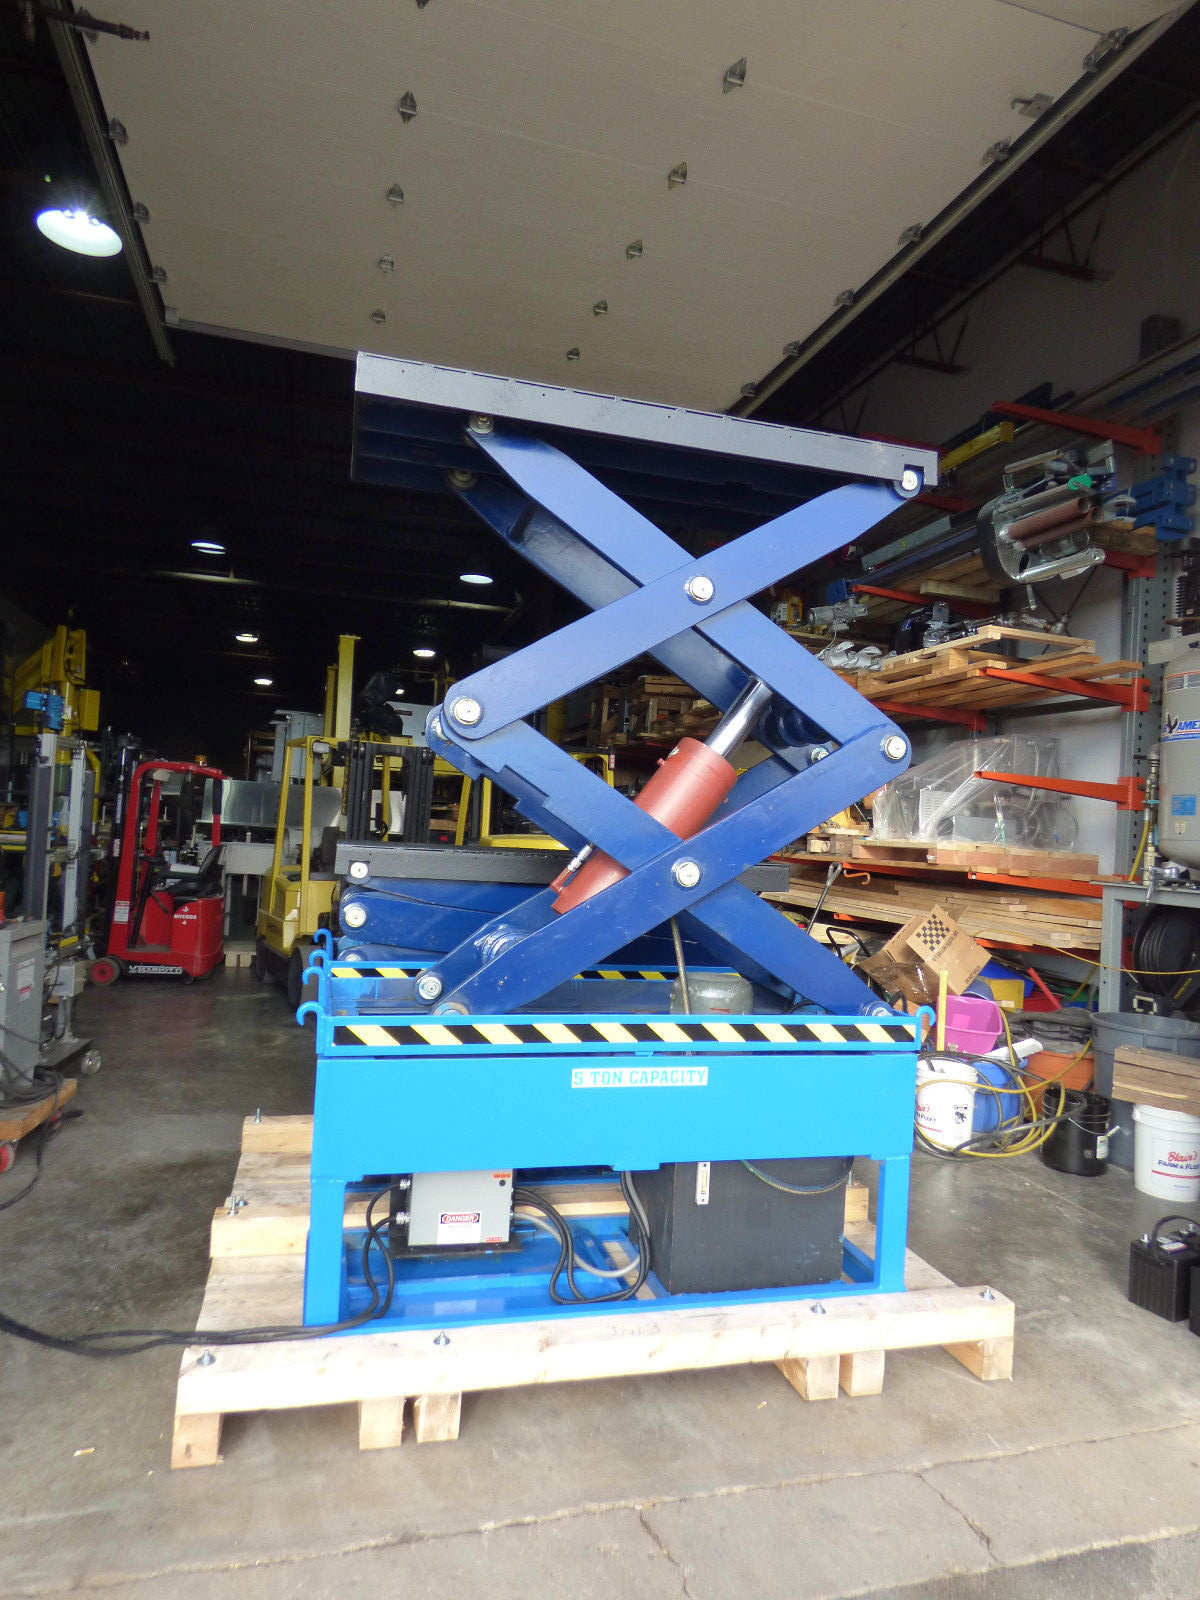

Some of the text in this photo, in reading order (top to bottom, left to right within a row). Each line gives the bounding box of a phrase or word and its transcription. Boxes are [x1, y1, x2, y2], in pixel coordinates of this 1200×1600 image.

[573, 1069, 707, 1086] 5 TON CAPACITY
[1168, 1150, 1198, 1162] Blain's
[1158, 1159, 1179, 1168] FARM
[446, 1214, 474, 1223] DANGER
